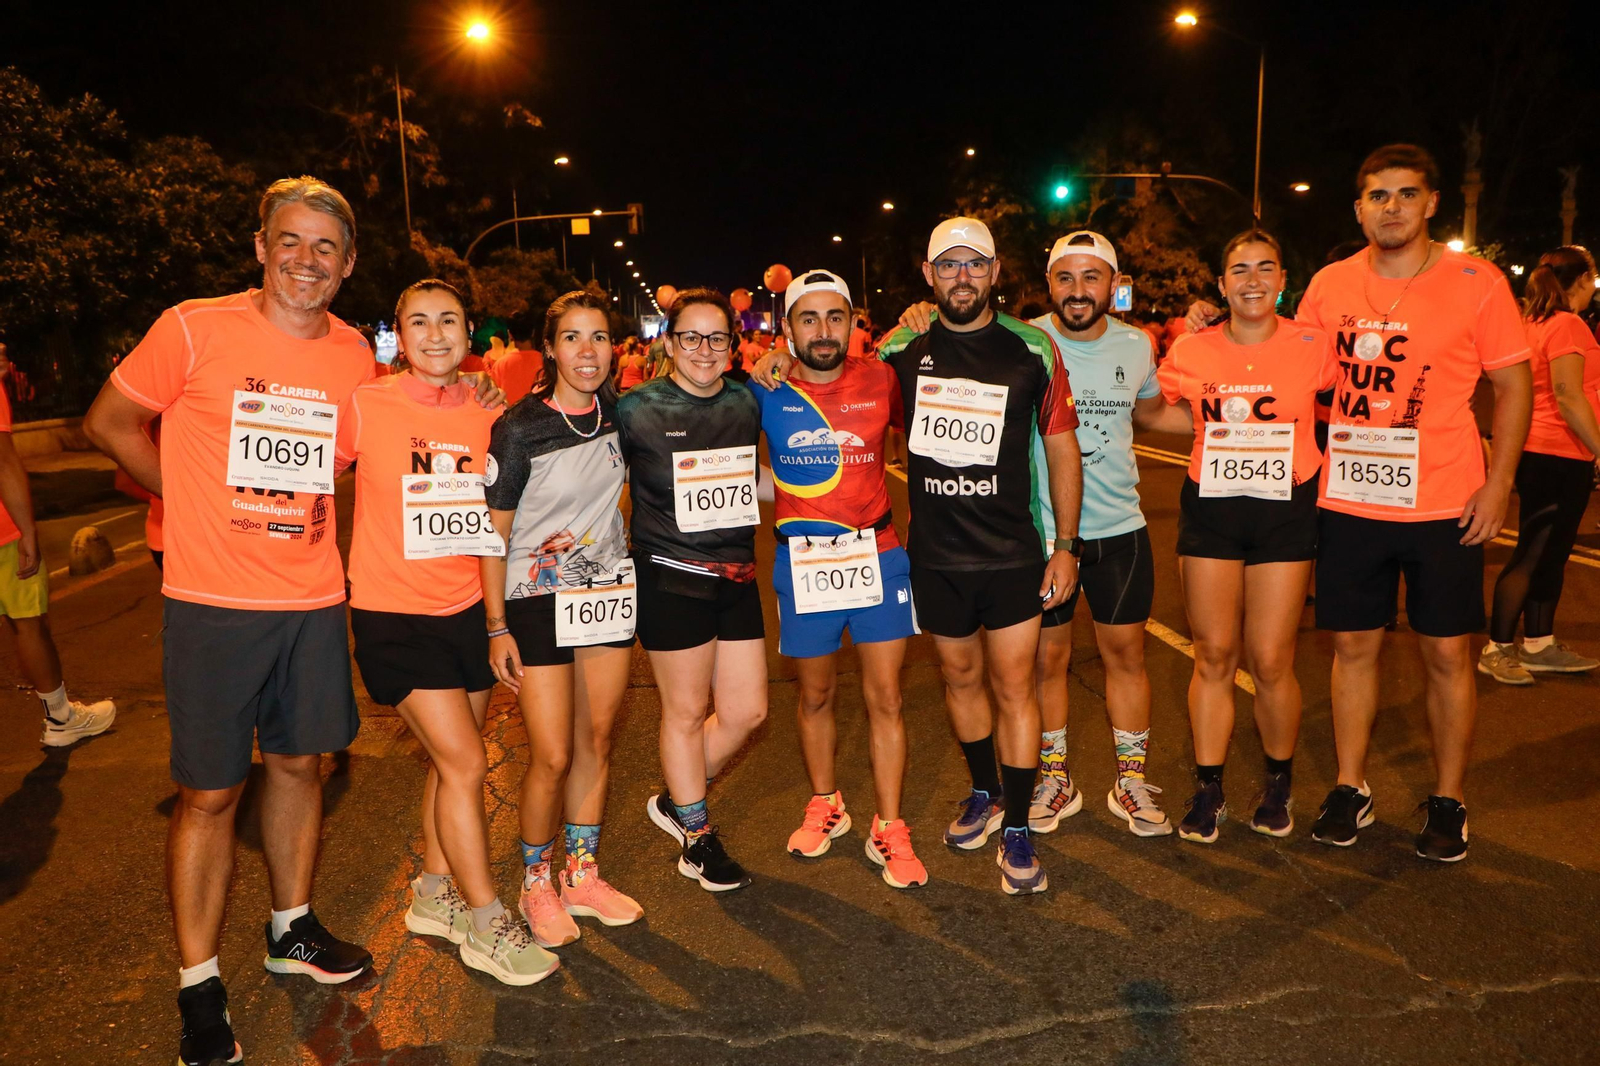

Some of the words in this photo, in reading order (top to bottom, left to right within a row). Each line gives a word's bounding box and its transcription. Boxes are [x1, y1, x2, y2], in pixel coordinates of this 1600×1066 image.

[1119, 287, 1128, 300] P
[1340, 315, 1356, 327] 36
[1357, 318, 1408, 331] CARRERA
[1202, 382, 1216, 394] 36
[1219, 384, 1273, 394] CARRERA
[1339, 360, 1395, 393] TUR
[245, 377, 266, 393] 36
[269, 383, 327, 400] CARRERA
[240, 402, 261, 411] KH7
[1339, 390, 1370, 420] NA
[921, 415, 995, 444] 16080
[239, 434, 324, 468] 10691
[410, 438, 426, 448] 36
[429, 441, 470, 453] CARRERA
[780, 453, 875, 465] GUADALQUIVIR
[1210, 458, 1285, 480] 18543
[924, 474, 998, 496] mobel
[1338, 460, 1411, 488] 18535
[232, 499, 305, 516] Guadalquivir
[683, 484, 752, 511] 16078
[412, 511, 494, 536] 10693
[801, 566, 874, 593] 16079
[565, 597, 632, 624] 16075
